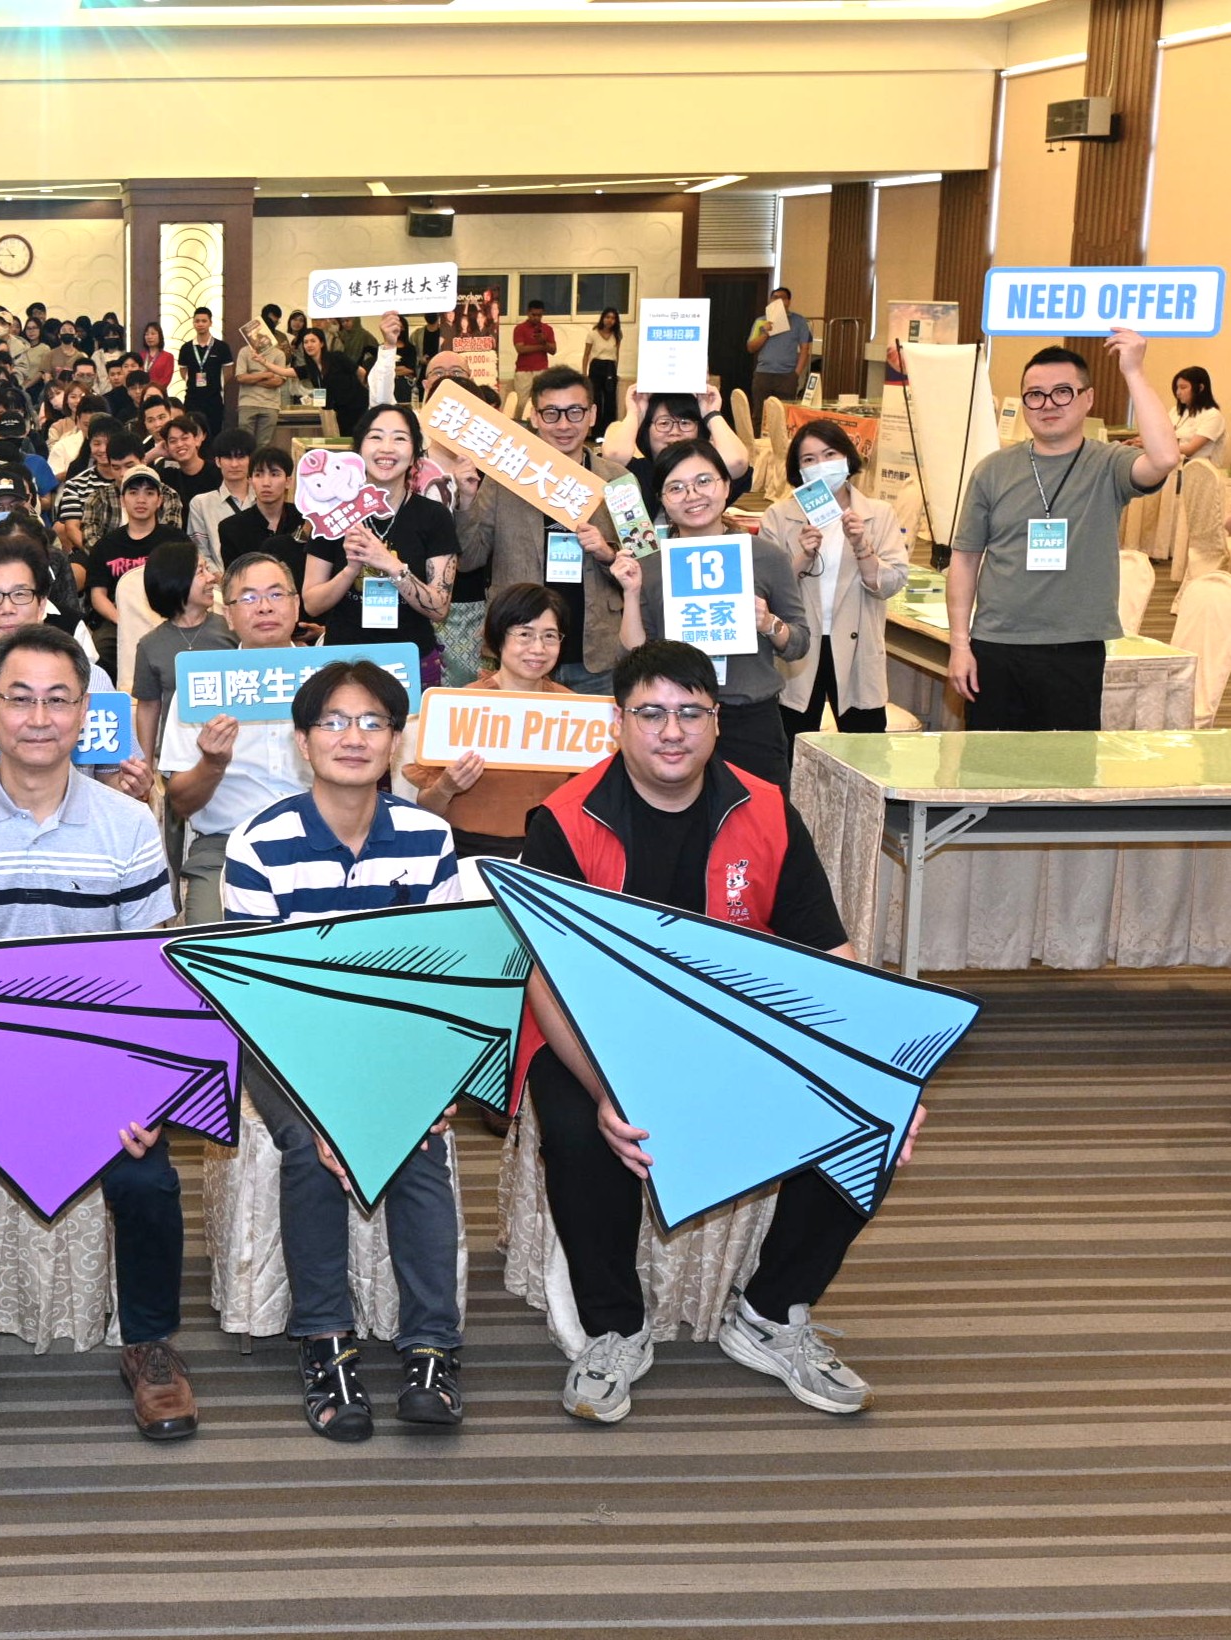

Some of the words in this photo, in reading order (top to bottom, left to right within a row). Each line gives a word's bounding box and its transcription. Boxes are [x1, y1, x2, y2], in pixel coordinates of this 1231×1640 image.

[348, 274, 451, 297] 健行科技大學
[1007, 284, 1086, 319] NEED
[1098, 283, 1197, 320] OFFER
[652, 329, 694, 340] 現場招募
[429, 396, 594, 520] 我要抽大獎
[804, 493, 830, 511] STAFF
[1032, 538, 1063, 547] STAFF
[551, 552, 578, 560] STAFF
[686, 550, 724, 590] 13
[366, 597, 396, 605] STAFF
[681, 600, 736, 628] 全家
[682, 628, 737, 642] 國際餐飲
[188, 663, 410, 708] 國際生
[449, 706, 511, 748] Win
[521, 710, 620, 754] Prizes
